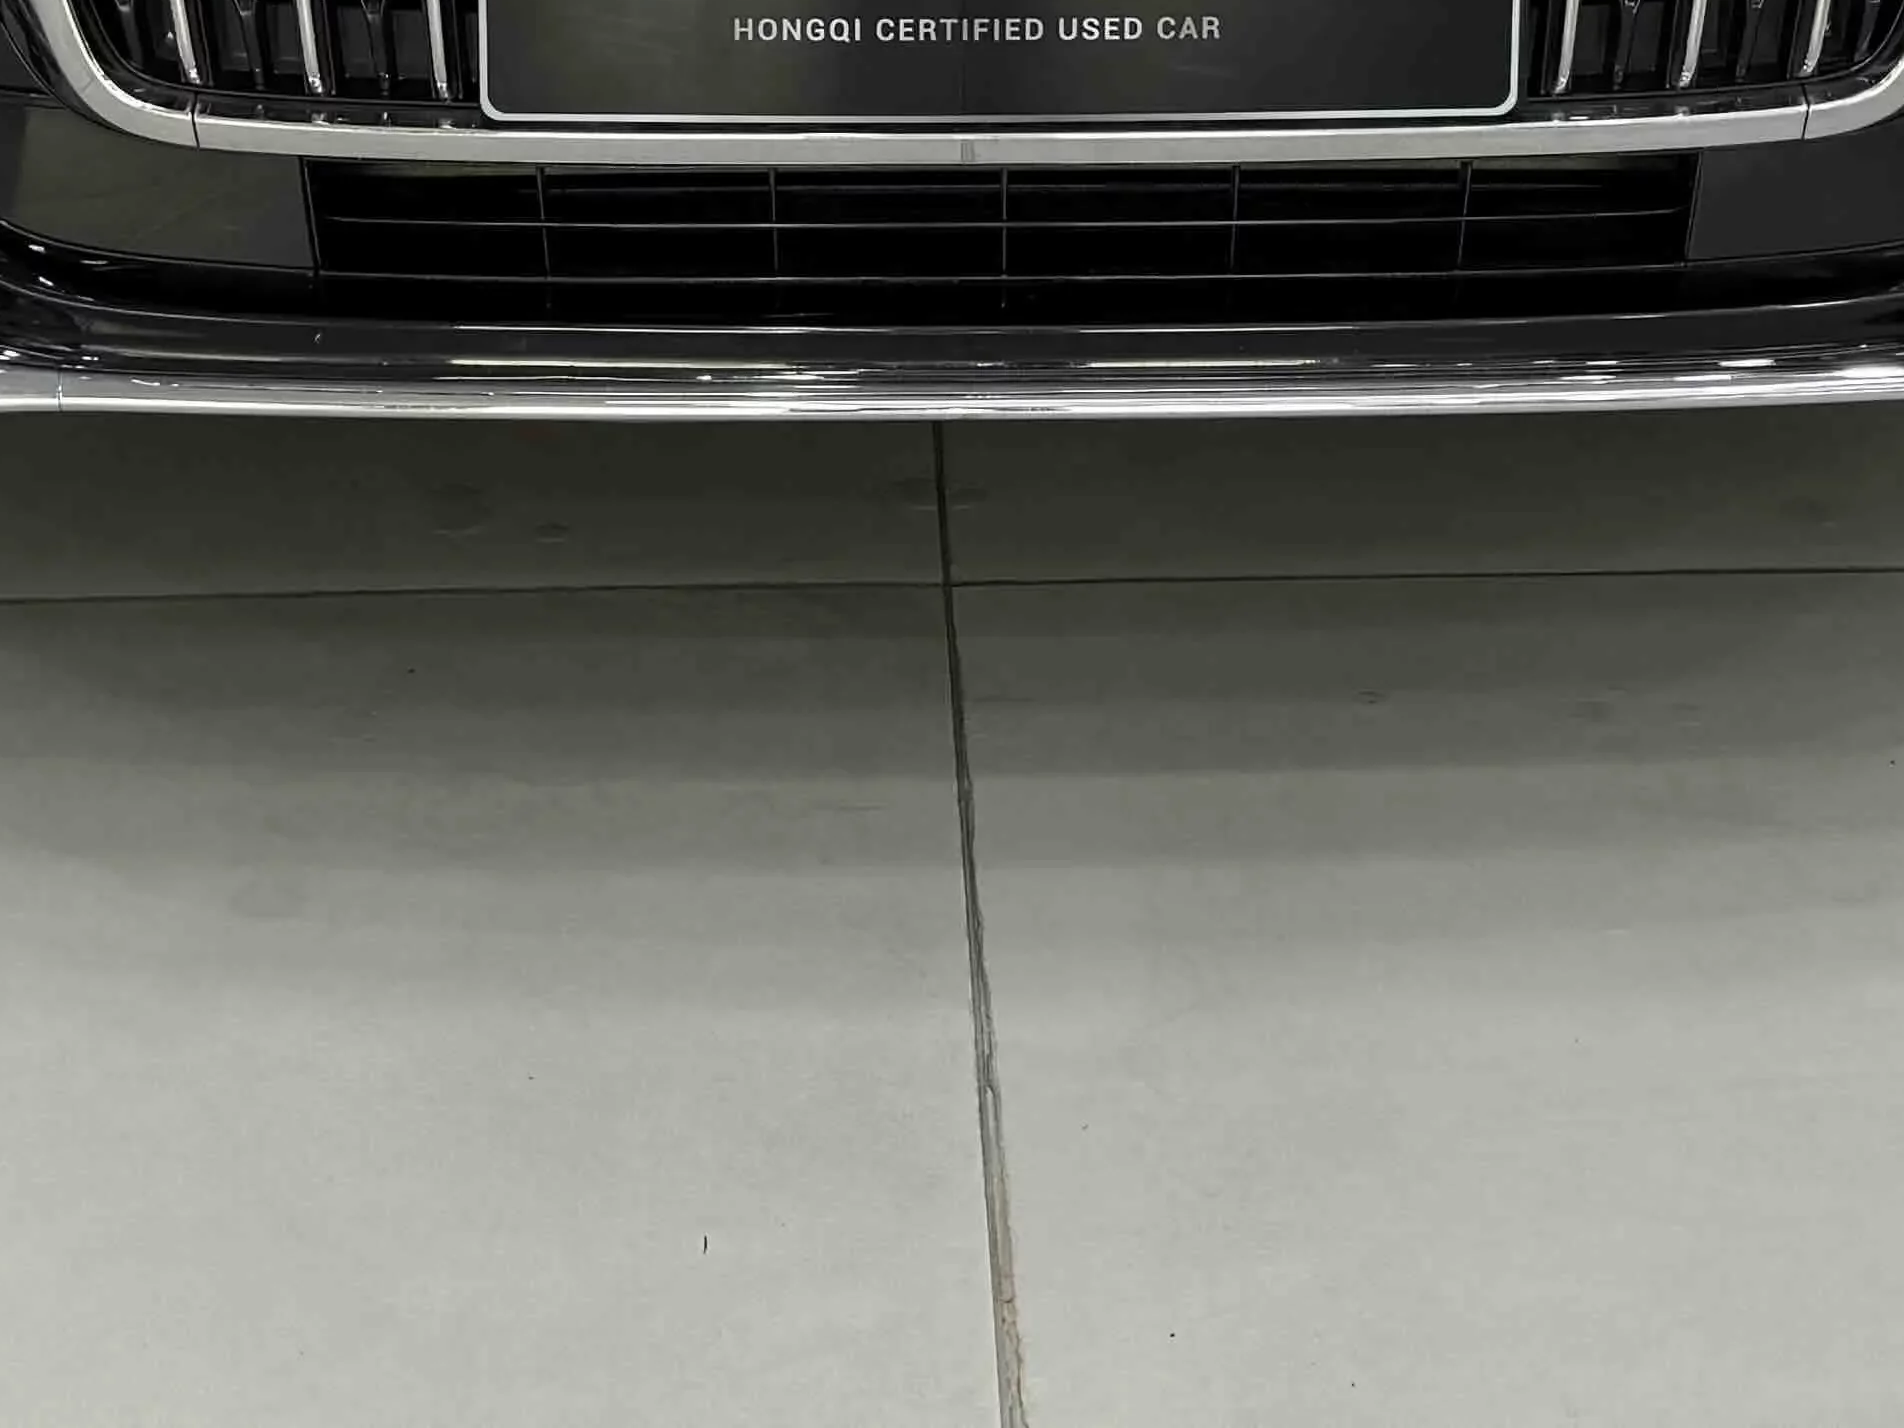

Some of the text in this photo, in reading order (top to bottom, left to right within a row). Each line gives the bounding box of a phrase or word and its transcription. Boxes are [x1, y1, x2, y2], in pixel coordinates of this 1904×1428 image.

[733, 16, 1221, 43] HONGQI CERTIFIED USED CAR
